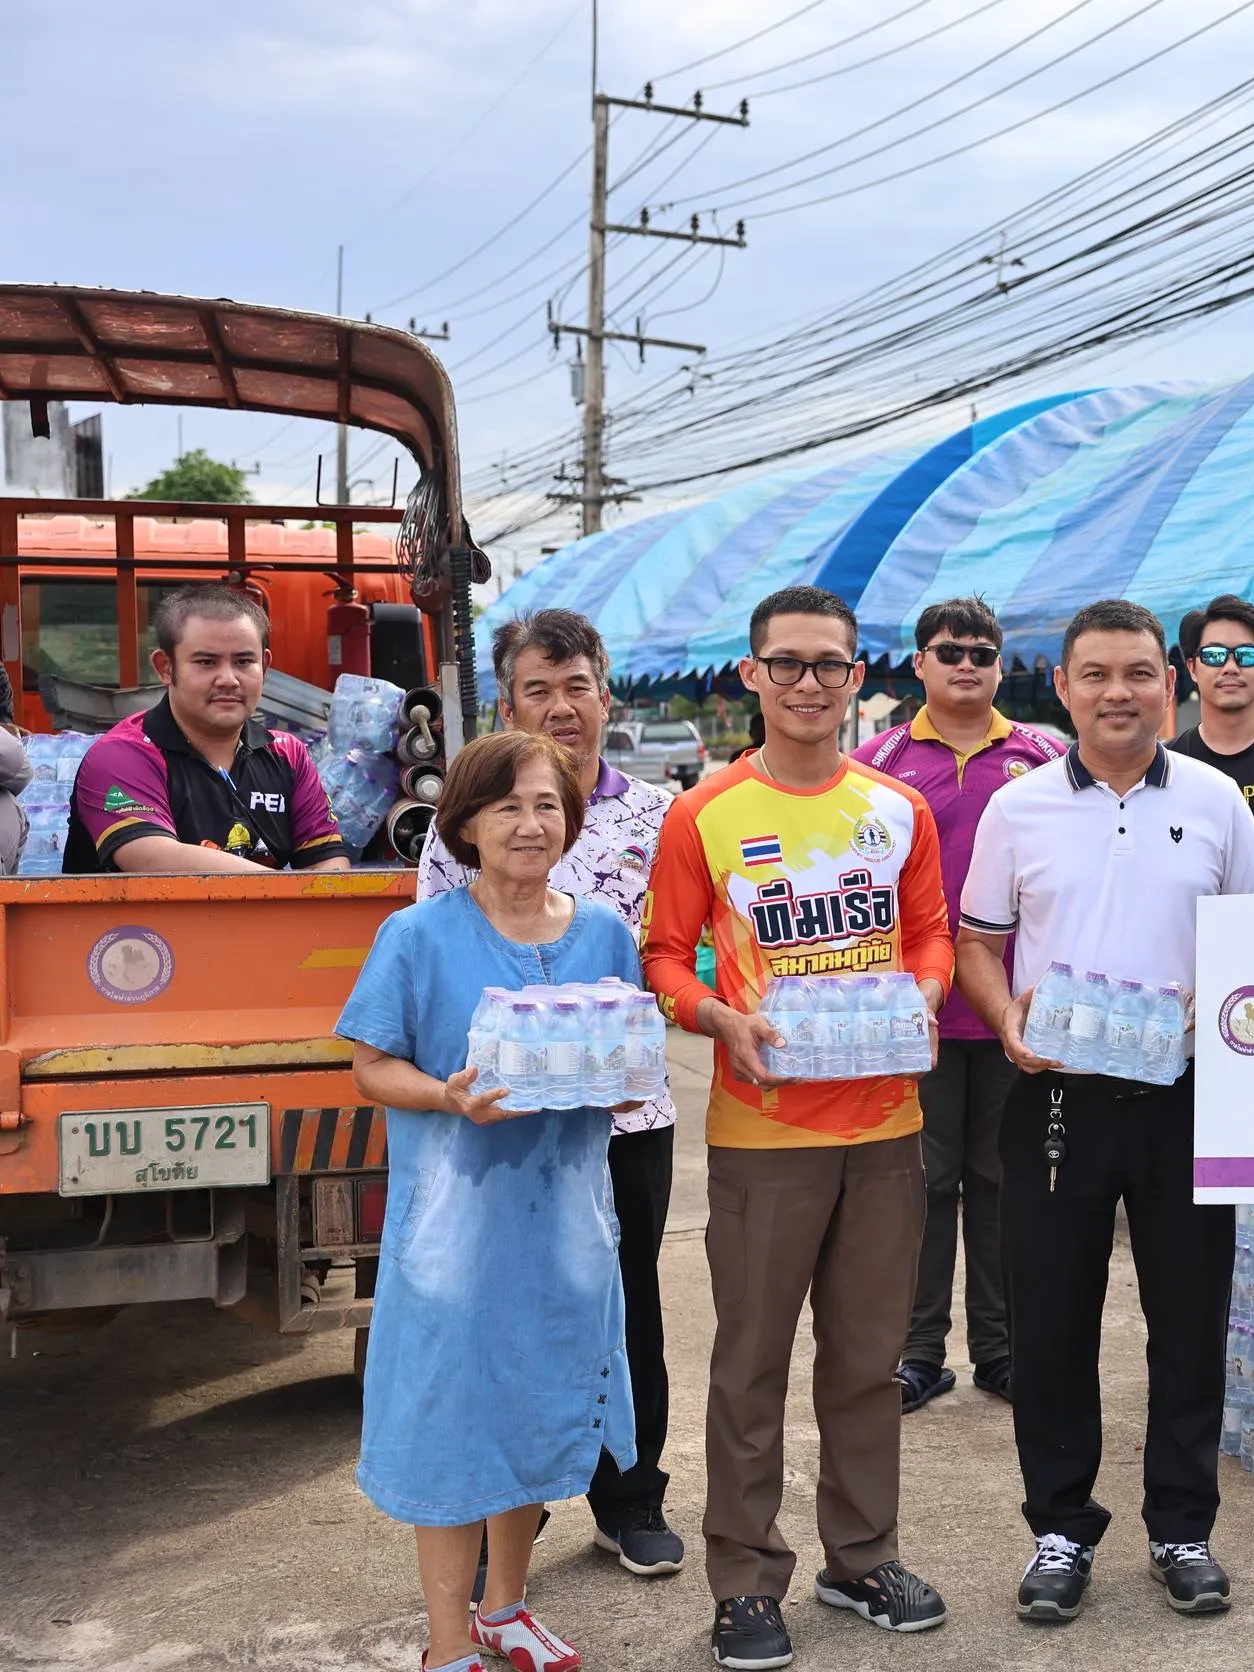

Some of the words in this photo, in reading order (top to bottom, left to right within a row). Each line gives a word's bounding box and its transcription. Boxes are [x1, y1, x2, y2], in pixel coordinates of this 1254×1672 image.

[1033, 735, 1060, 761] SUKHO
[750, 870, 895, 946] ทีมเรือ
[84, 1120, 142, 1157] บบ
[164, 1114, 257, 1152] 5721
